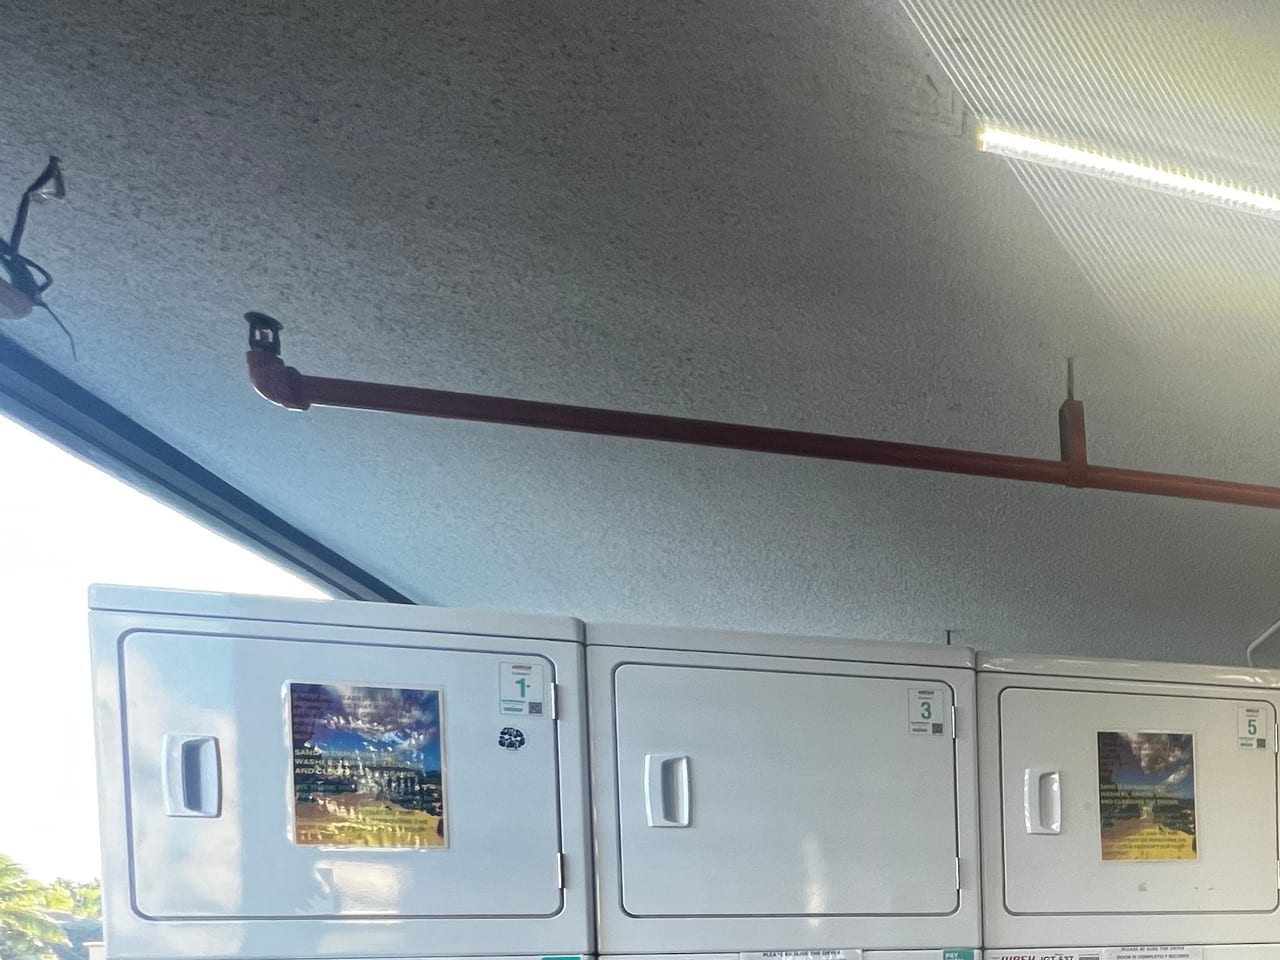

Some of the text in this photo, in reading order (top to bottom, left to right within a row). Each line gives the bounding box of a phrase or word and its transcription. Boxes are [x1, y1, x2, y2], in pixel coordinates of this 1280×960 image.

[515, 678, 526, 698] 1
[921, 701, 931, 719] 3
[1248, 719, 1256, 735] 5
